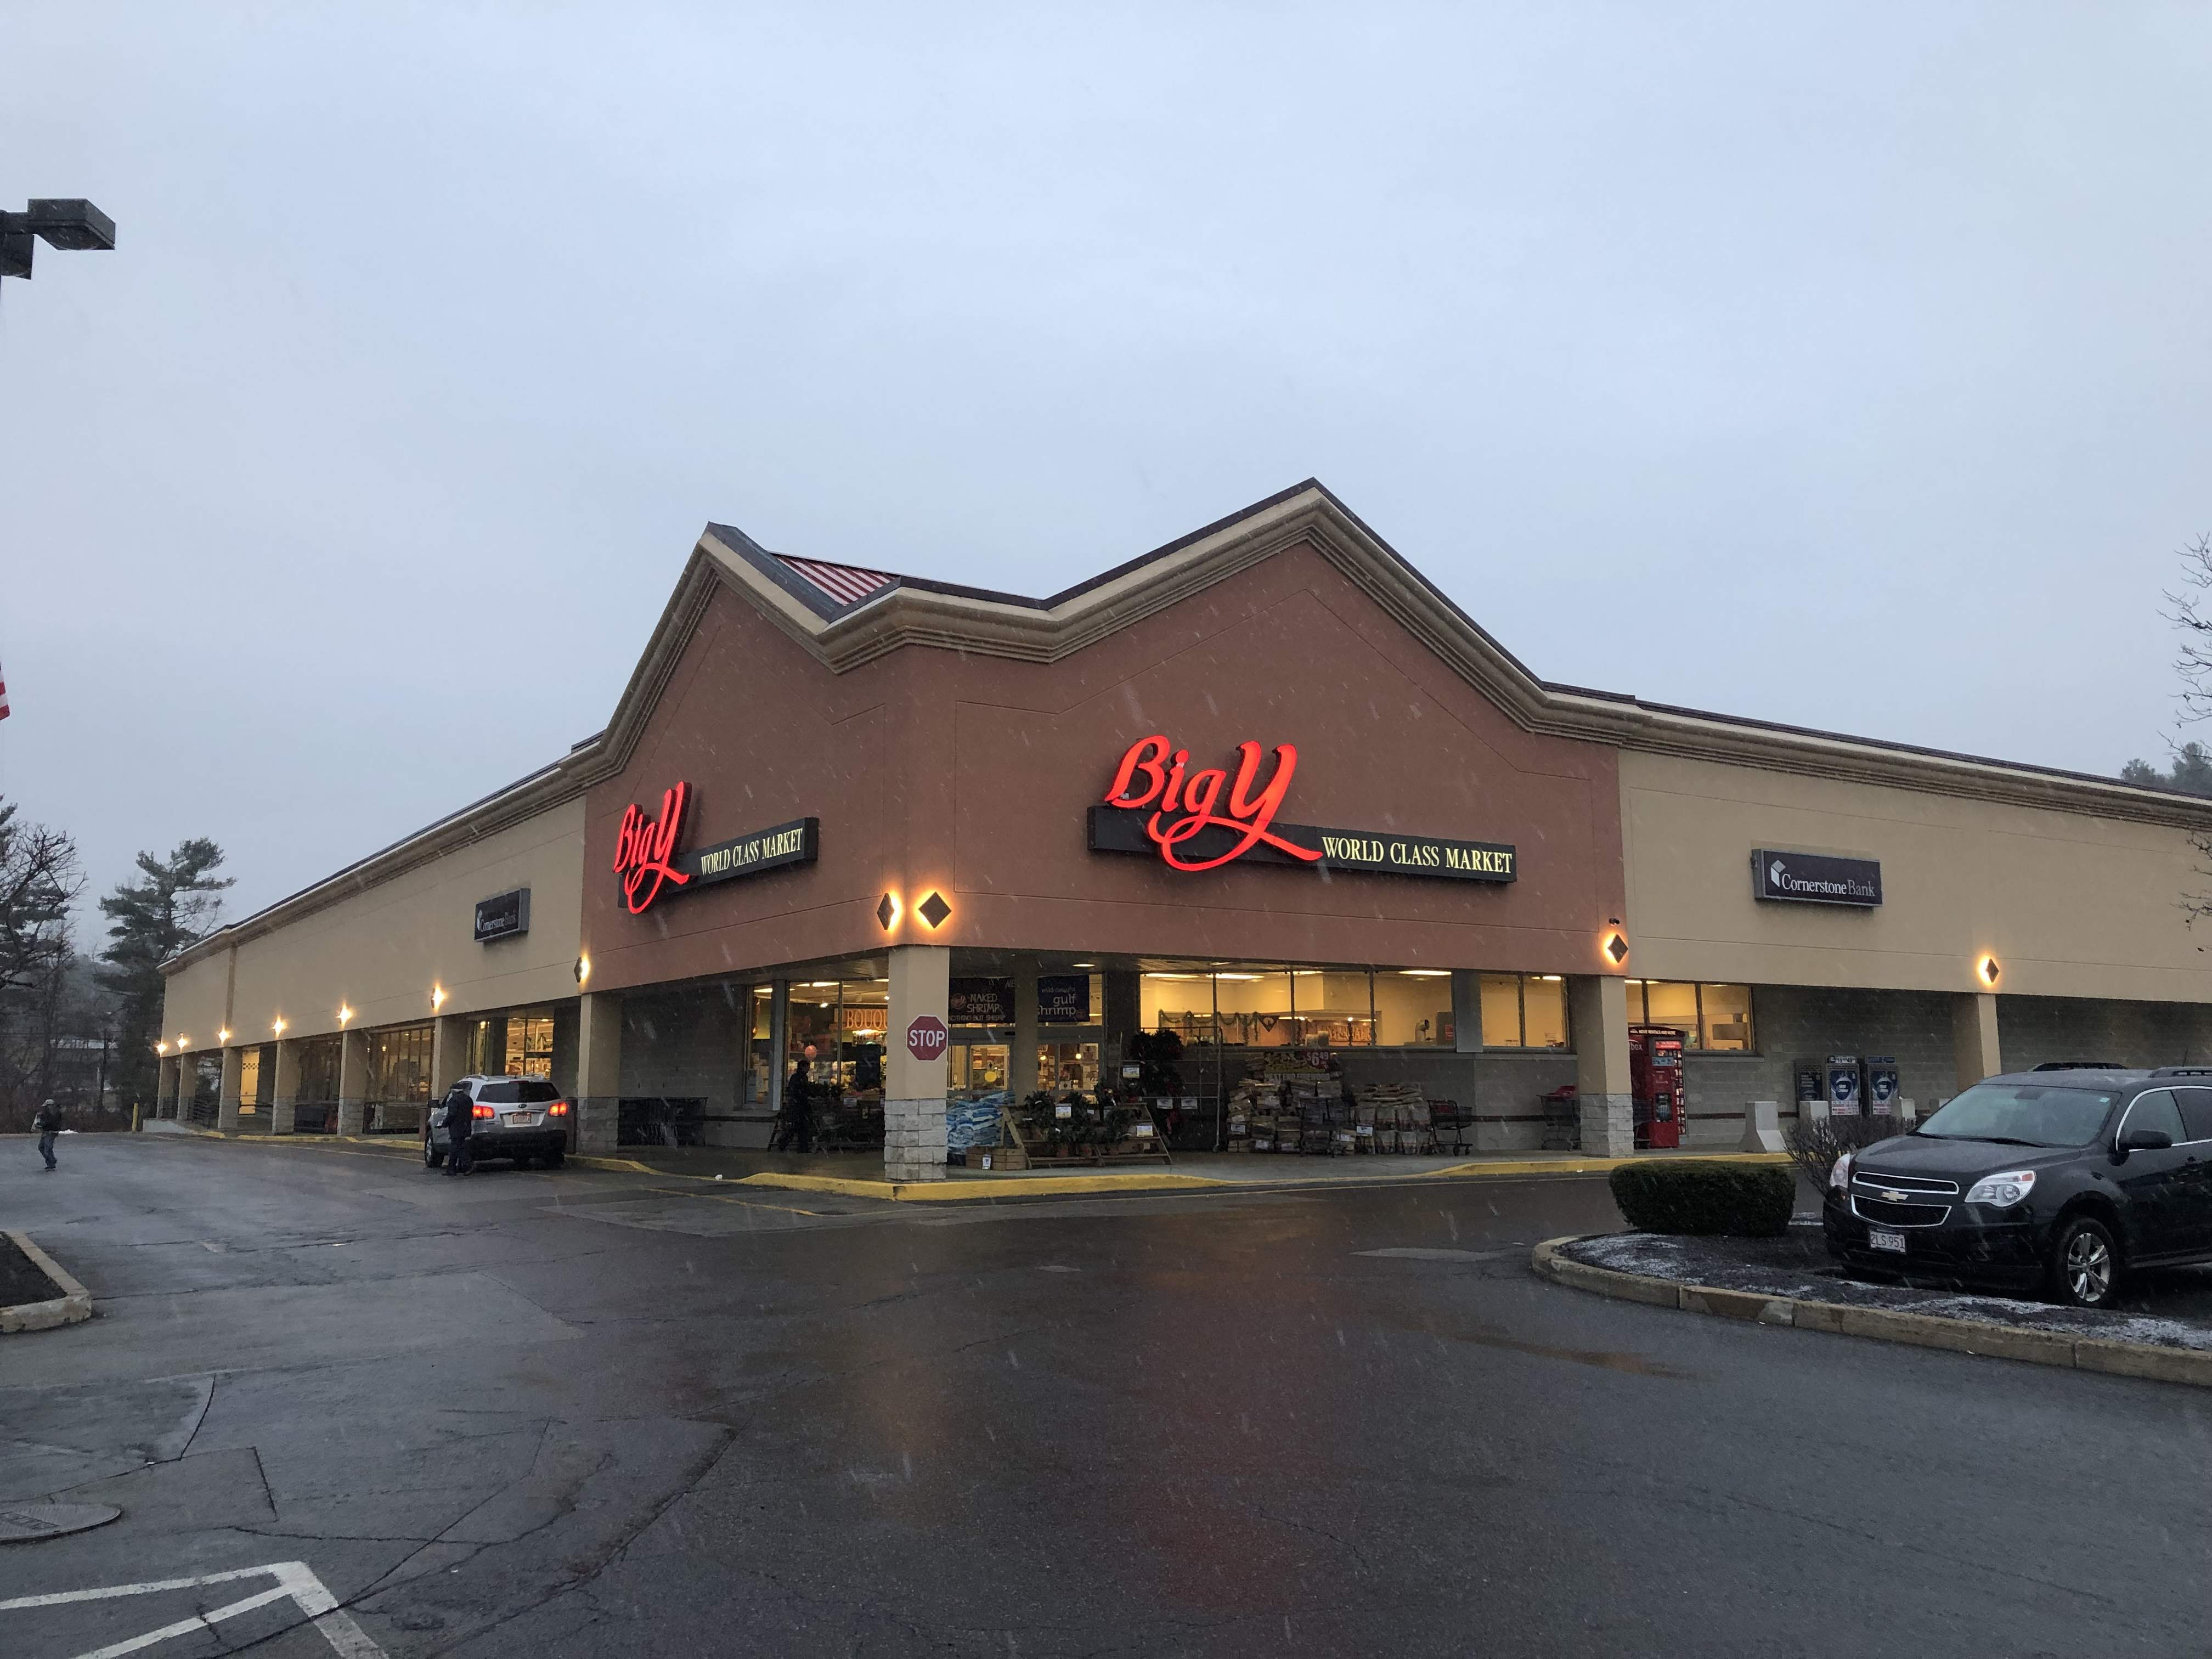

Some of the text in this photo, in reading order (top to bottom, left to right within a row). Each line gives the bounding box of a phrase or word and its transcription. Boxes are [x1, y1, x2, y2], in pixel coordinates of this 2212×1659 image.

[701, 828, 803, 876] WORLD CLASS MARKET
[1322, 836, 1513, 873] WORLD CLASS MARKET
[970, 993, 997, 1002] NAKED
[1053, 994, 1076, 1007] gulf
[967, 1003, 1000, 1013] SHRIMP
[909, 1030, 945, 1047] STOP
[1888, 1235, 1905, 1249] 951
